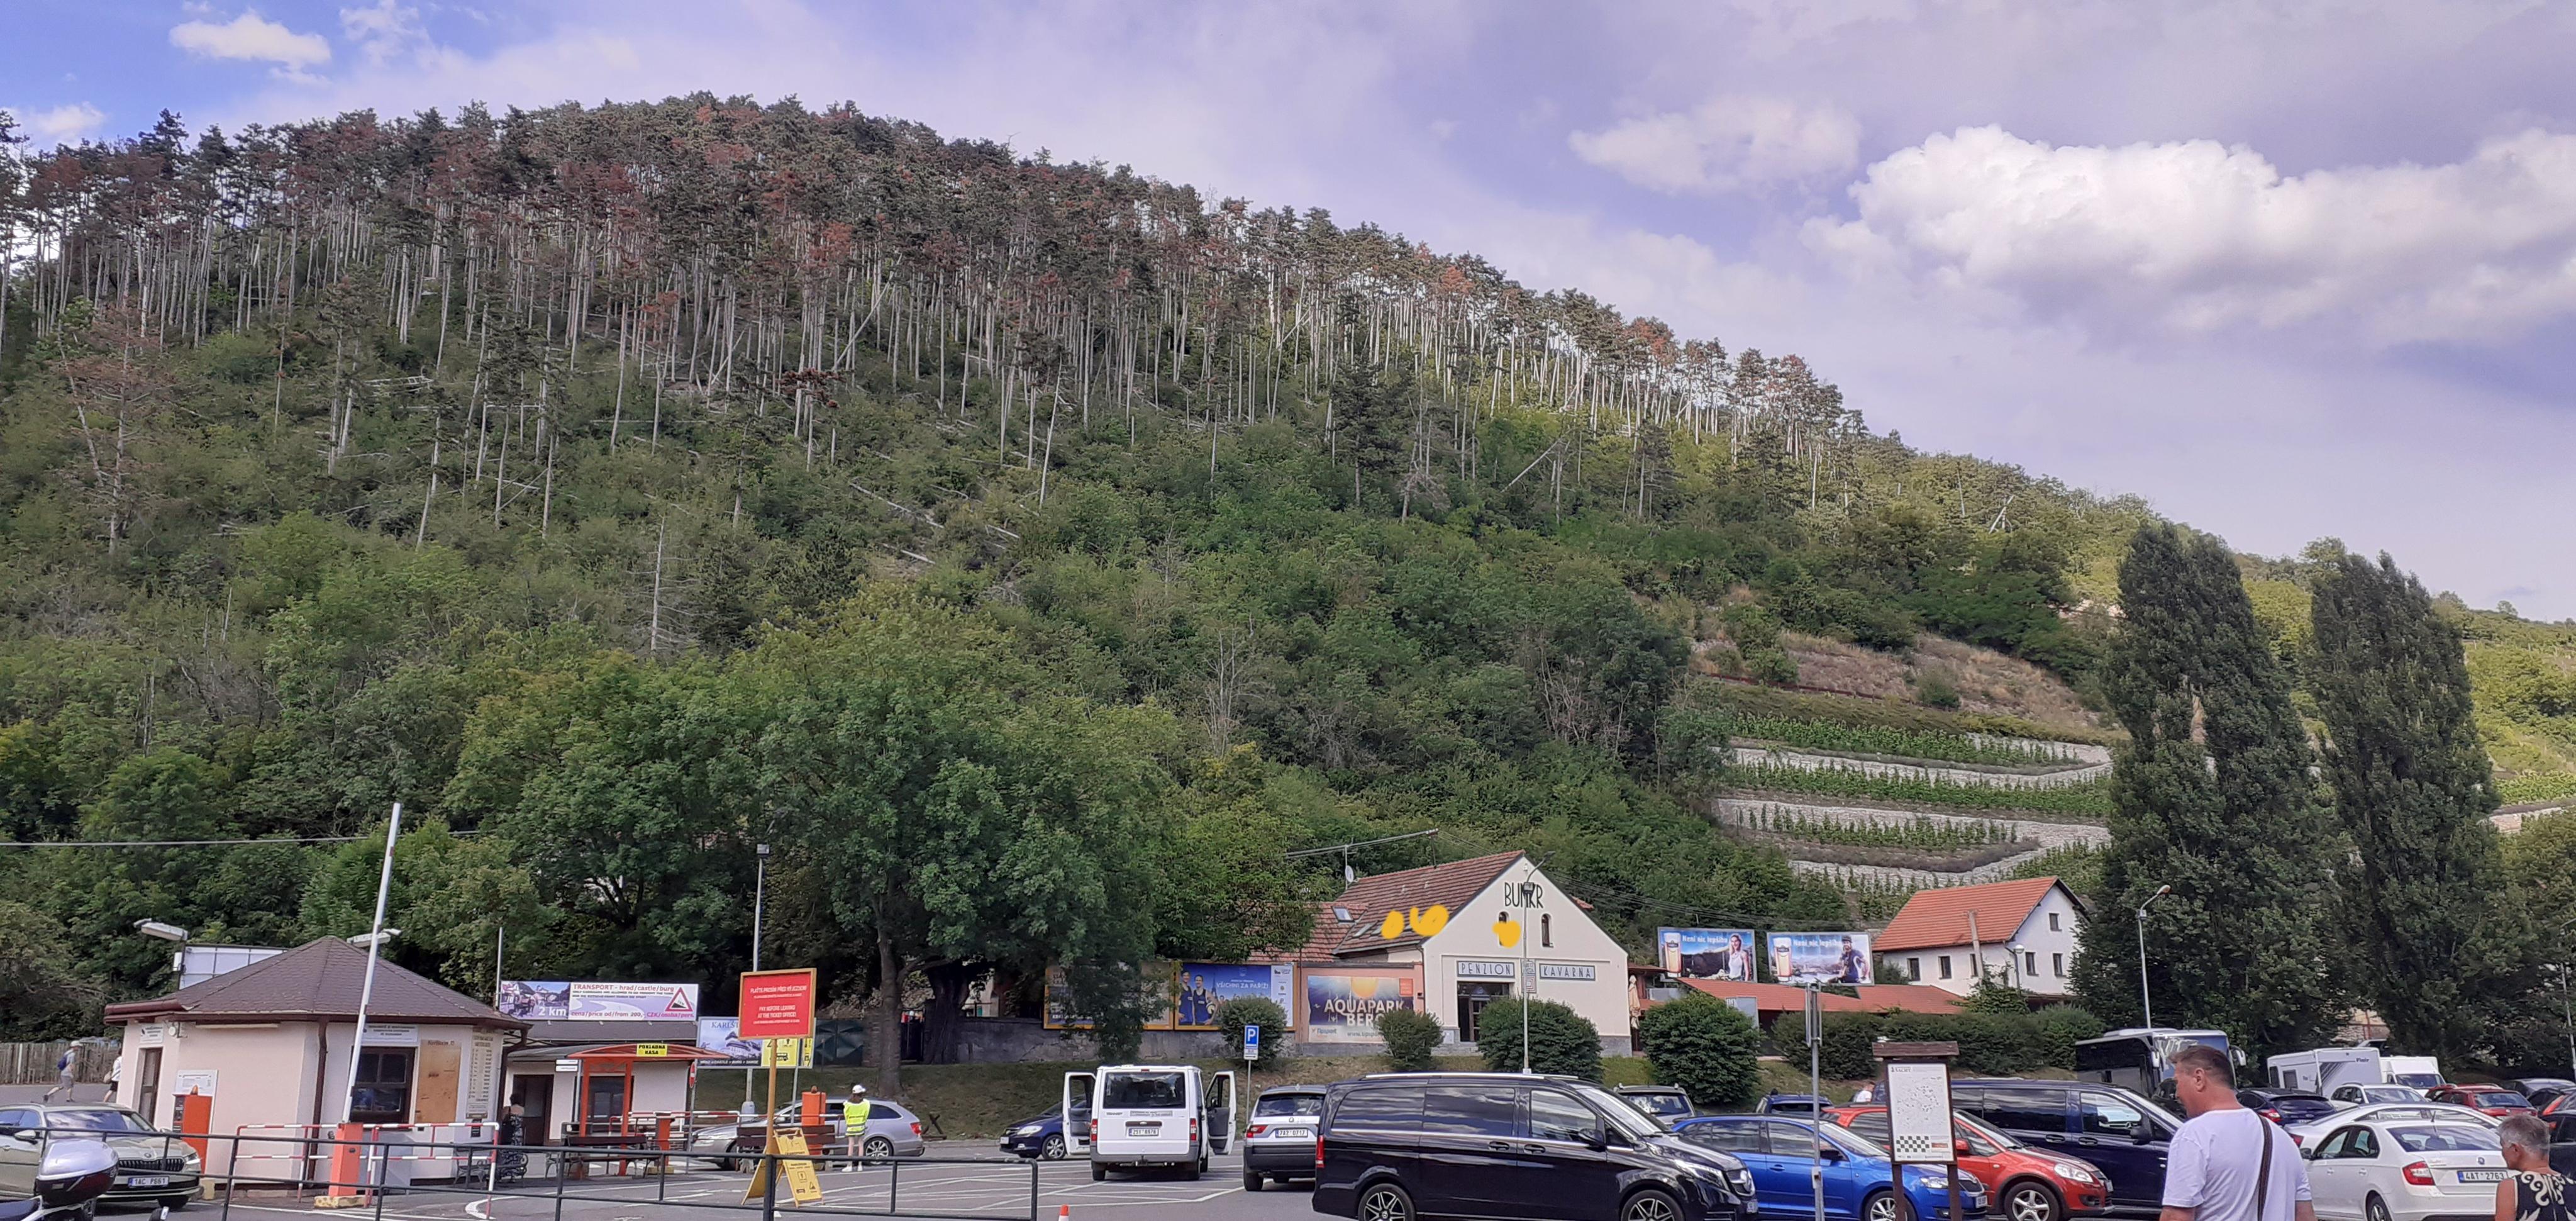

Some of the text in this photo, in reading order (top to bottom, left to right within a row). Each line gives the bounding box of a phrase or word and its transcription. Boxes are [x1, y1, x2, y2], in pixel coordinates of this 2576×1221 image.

[1461, 963, 1511, 975] PENZION
[538, 1006, 567, 1016] 2 km
[1323, 999, 1405, 1015] AQUAPARK
[1248, 1029, 1256, 1042] P
[2465, 1172, 2504, 1180] 4AT 2763
